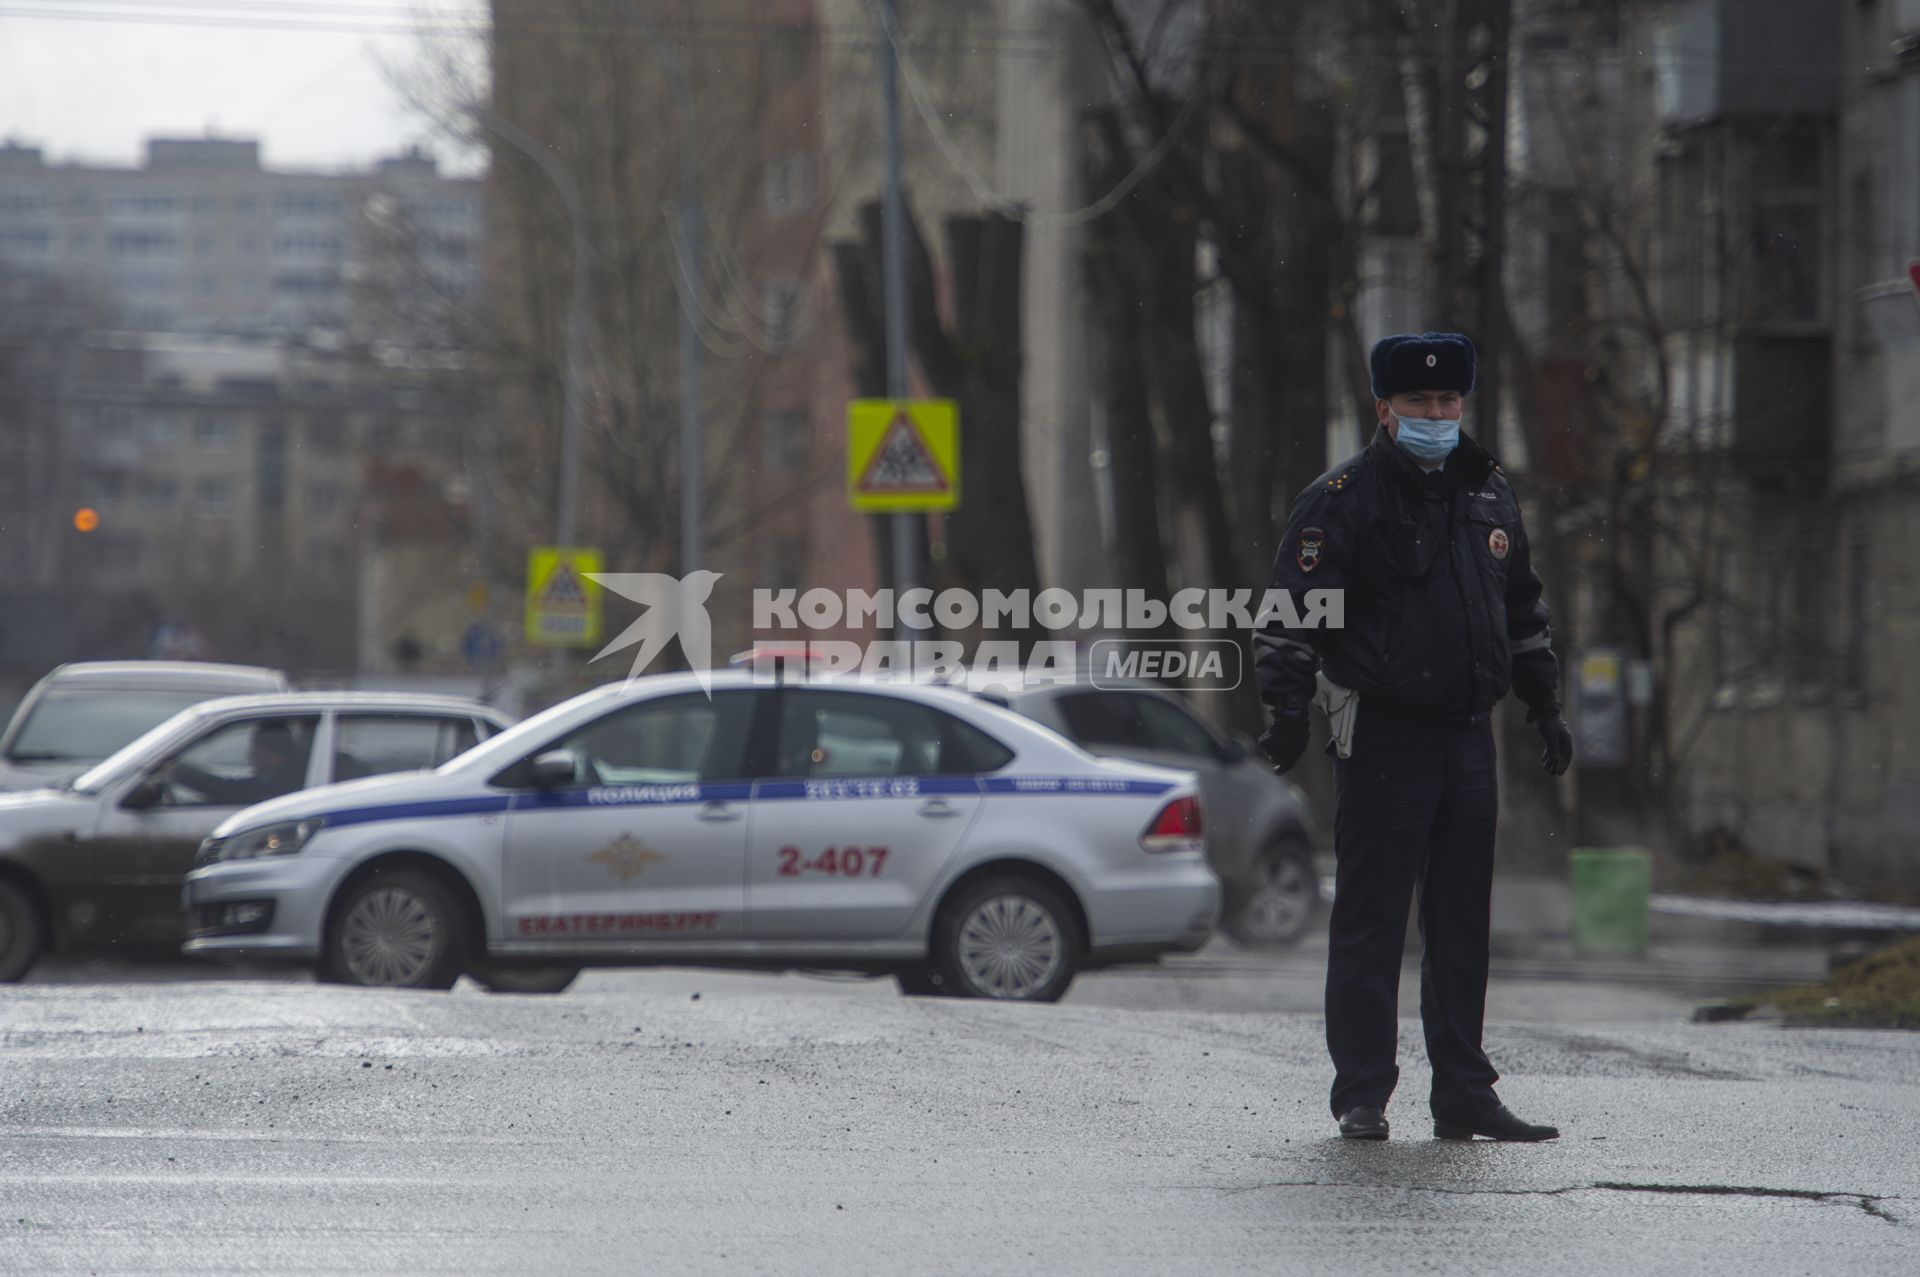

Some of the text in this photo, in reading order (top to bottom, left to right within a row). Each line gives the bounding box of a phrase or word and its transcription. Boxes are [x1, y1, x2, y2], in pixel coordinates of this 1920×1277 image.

[588, 784, 700, 805] ПОЛИЦИЯ
[776, 845, 889, 878] 2-407
[518, 911, 719, 936] ЕКАТЕРИНБУРГ
